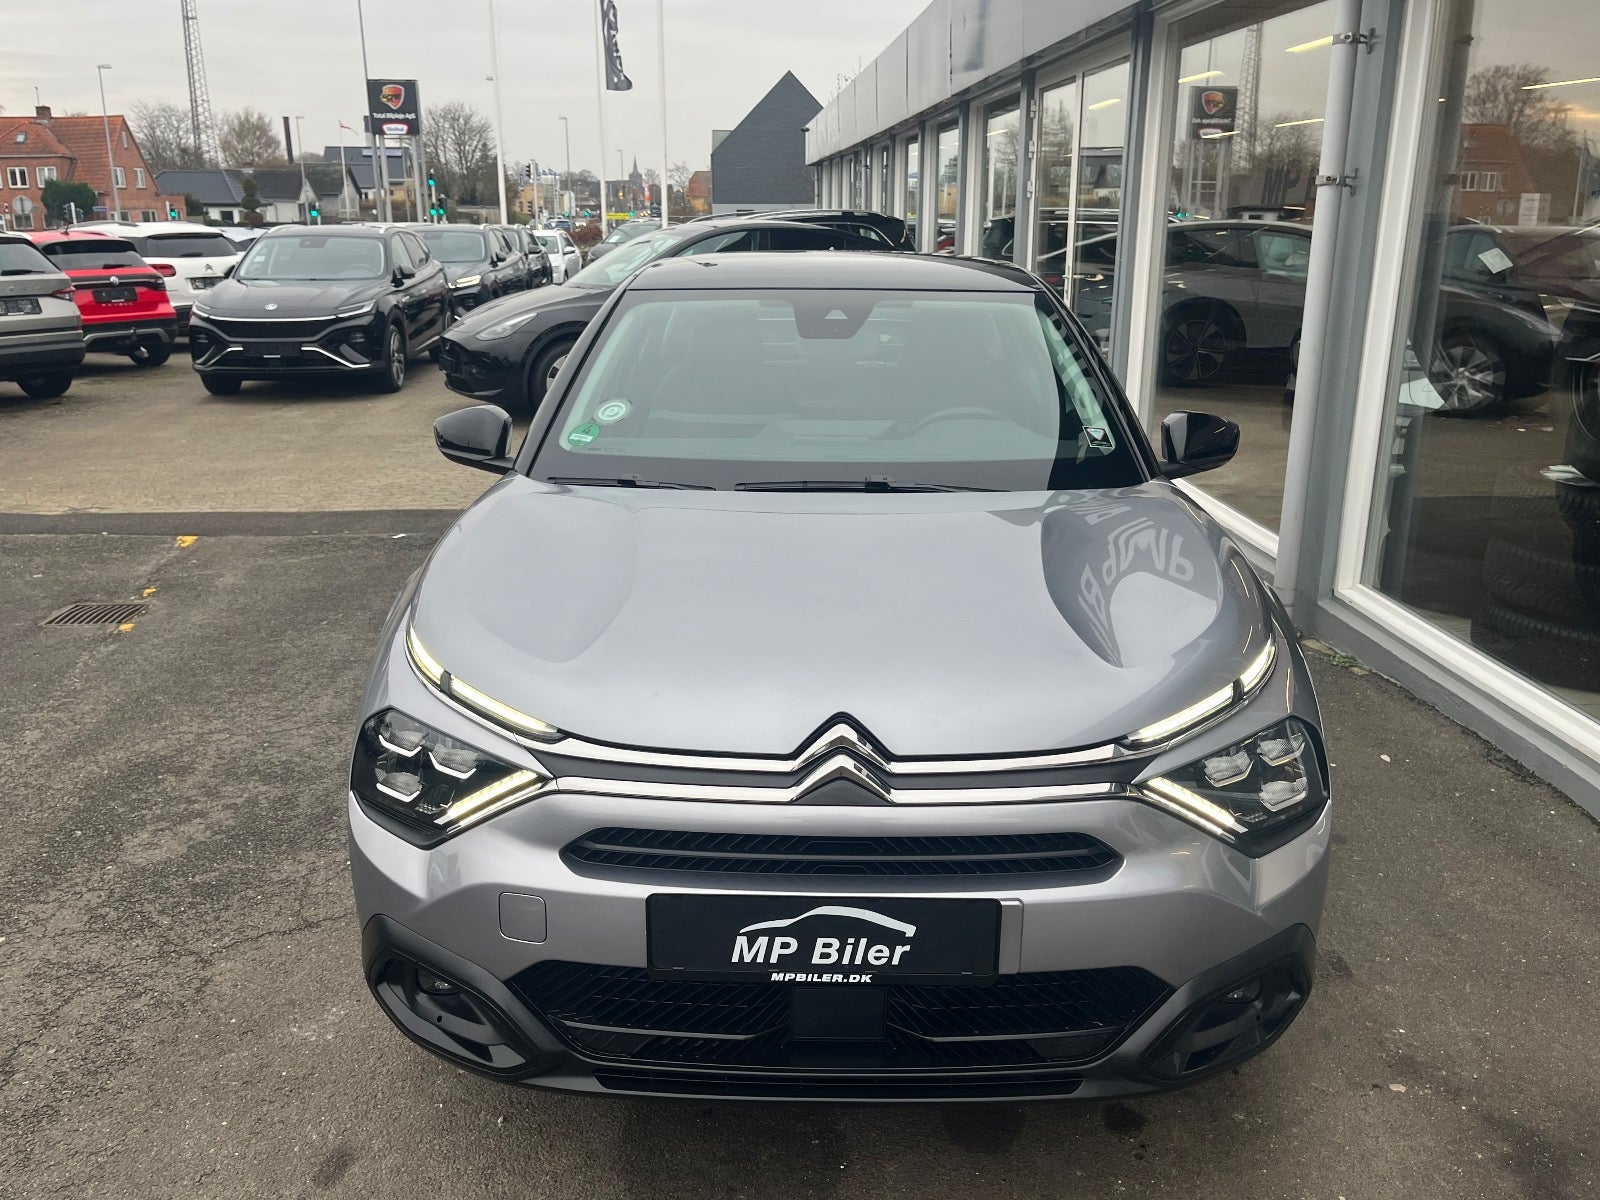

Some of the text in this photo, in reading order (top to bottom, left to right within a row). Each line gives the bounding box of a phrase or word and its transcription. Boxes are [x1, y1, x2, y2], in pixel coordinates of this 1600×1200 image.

[731, 935, 911, 966] MP Biler
[771, 972, 873, 983] MPBILER.DK
